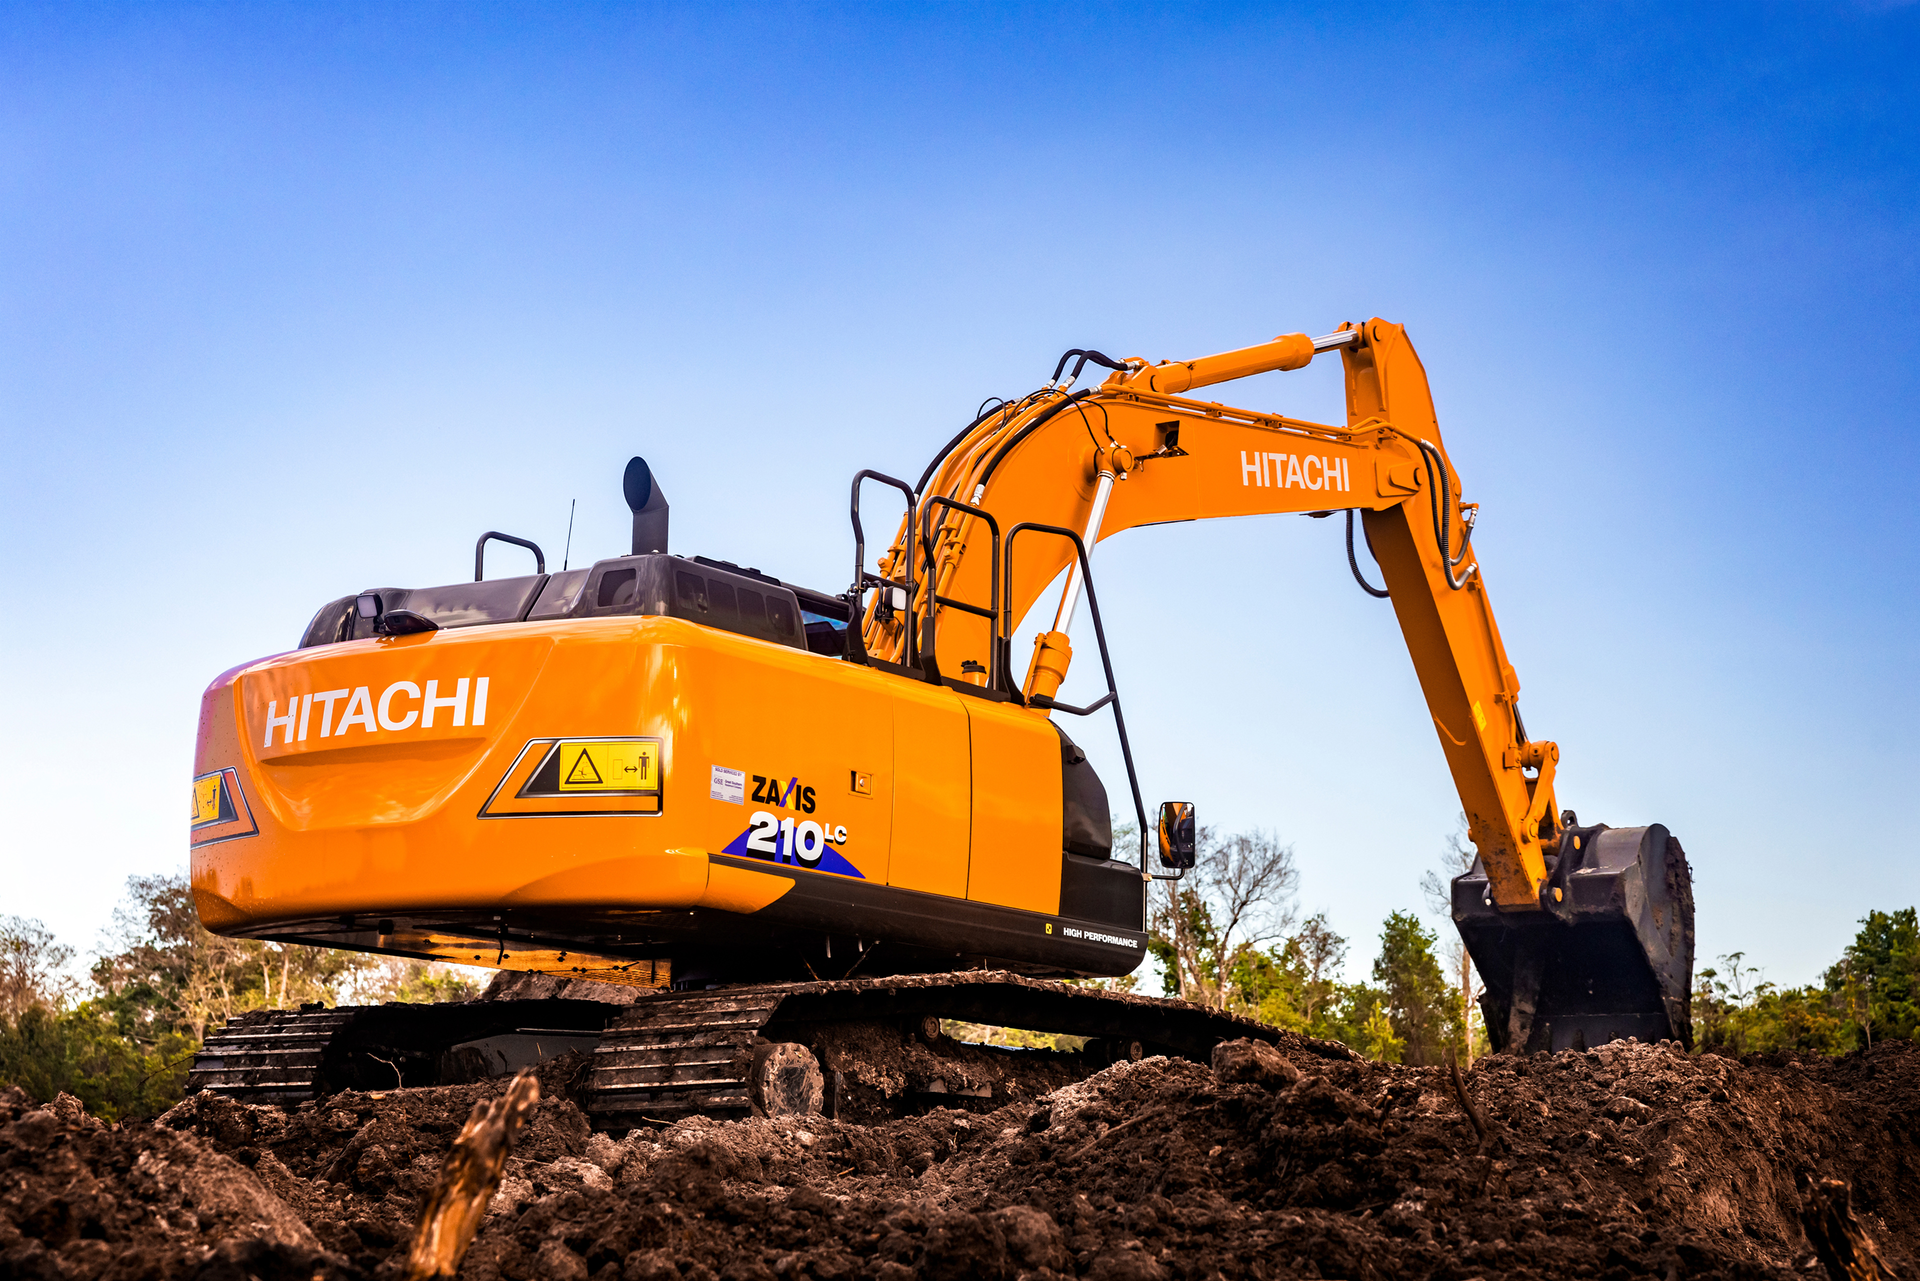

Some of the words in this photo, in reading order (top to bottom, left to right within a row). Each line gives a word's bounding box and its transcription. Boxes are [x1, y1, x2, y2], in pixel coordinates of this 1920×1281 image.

[1240, 450, 1350, 492] HITACHI
[264, 676, 490, 748] HITACHI
[751, 774, 816, 814] ZAXIS
[1063, 927, 1082, 939] HIGH
[1083, 931, 1138, 948] PERFORMANCE
